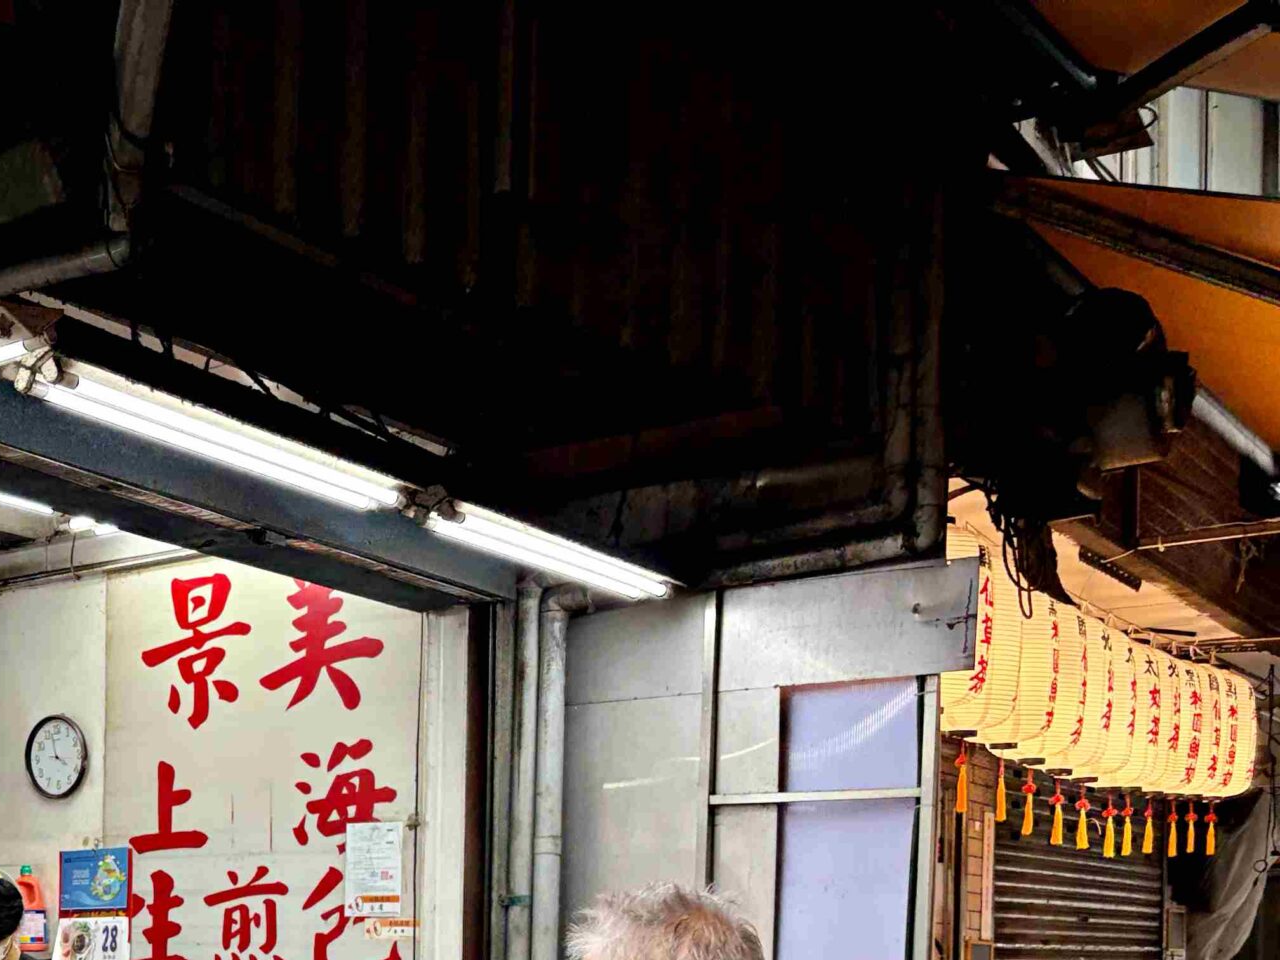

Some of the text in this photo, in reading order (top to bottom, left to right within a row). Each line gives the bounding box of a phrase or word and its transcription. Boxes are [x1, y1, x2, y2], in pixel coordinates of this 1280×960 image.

[141, 572, 385, 730] 景美
[129, 738, 398, 856] 上海
[102, 924, 119, 953] 28
